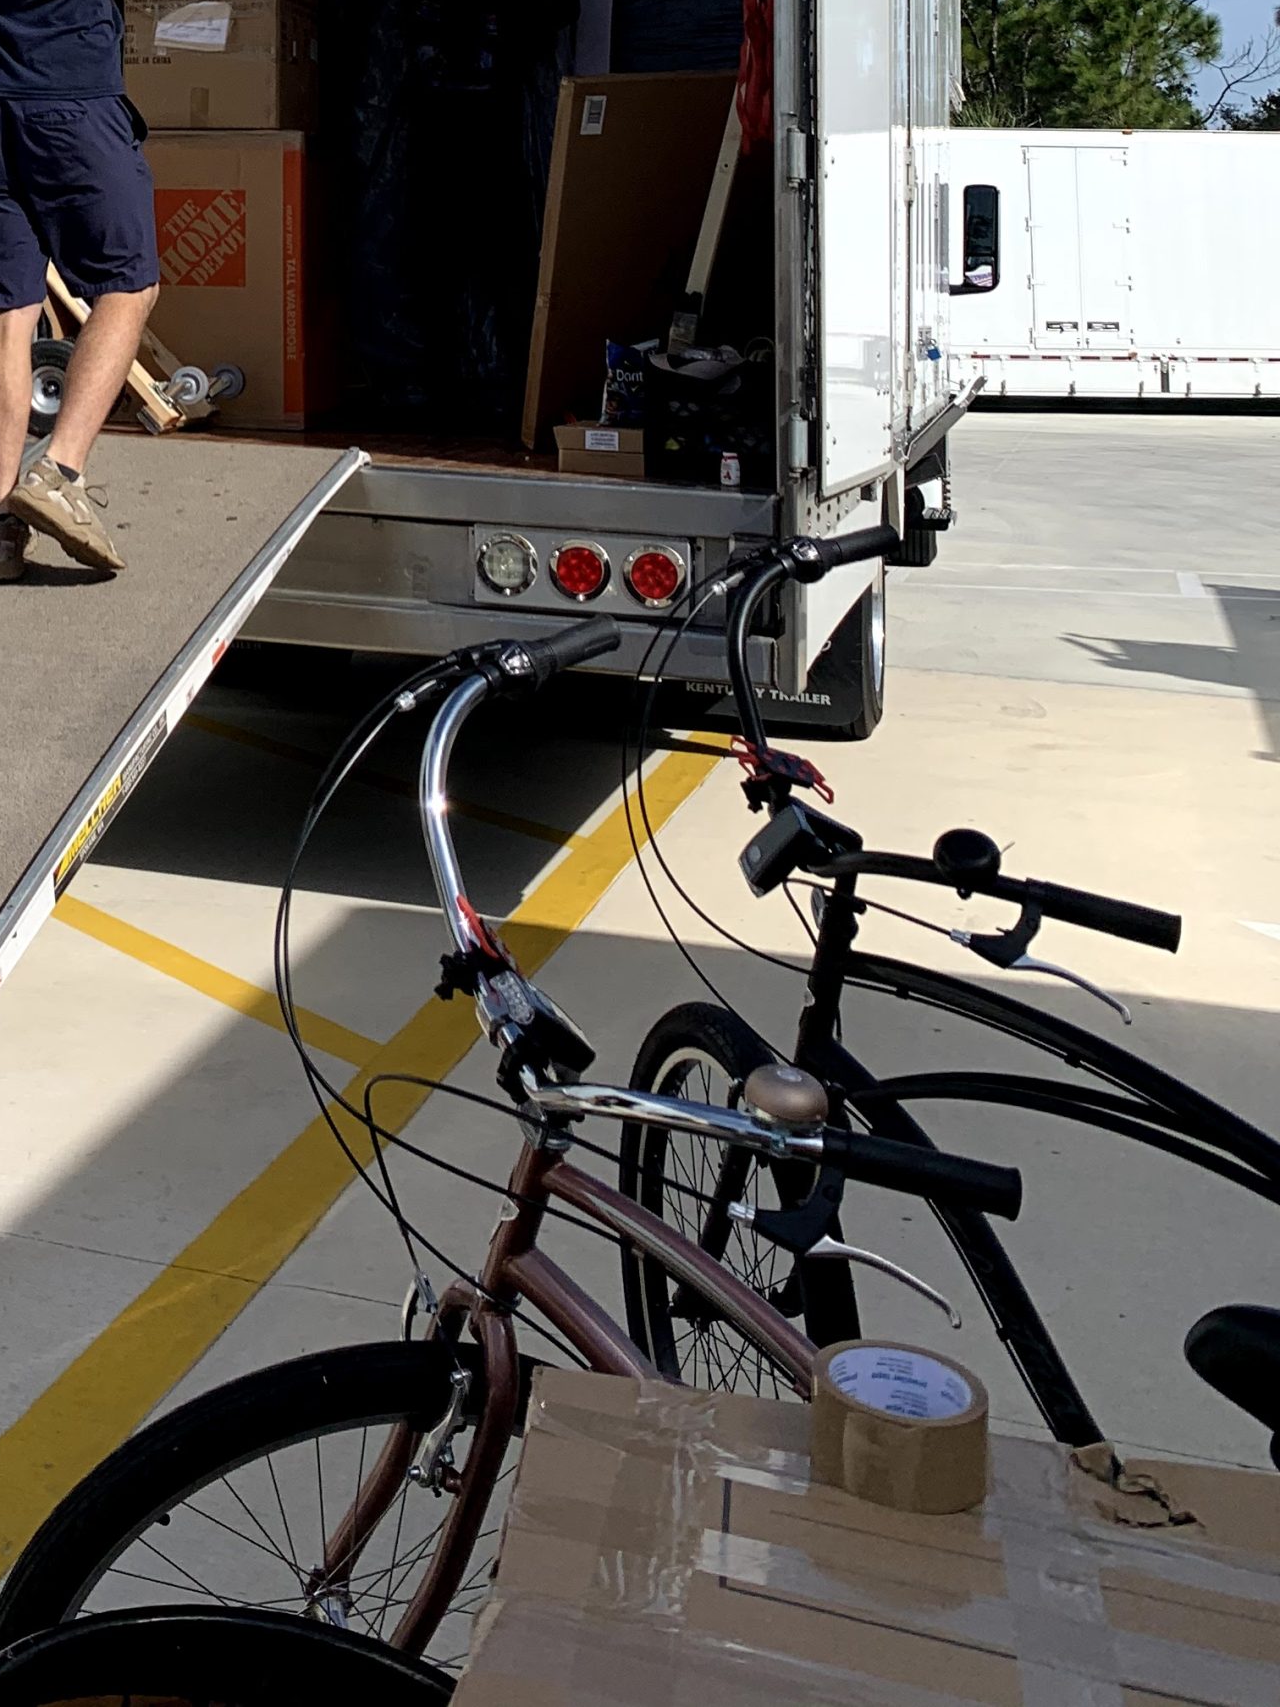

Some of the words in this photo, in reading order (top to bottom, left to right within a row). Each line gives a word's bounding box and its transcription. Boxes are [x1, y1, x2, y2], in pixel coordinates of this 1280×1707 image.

[159, 190, 245, 286] HOME
[162, 199, 200, 237] THE
[190, 225, 245, 286] DEPOT
[686, 681, 766, 699] KENTUY
